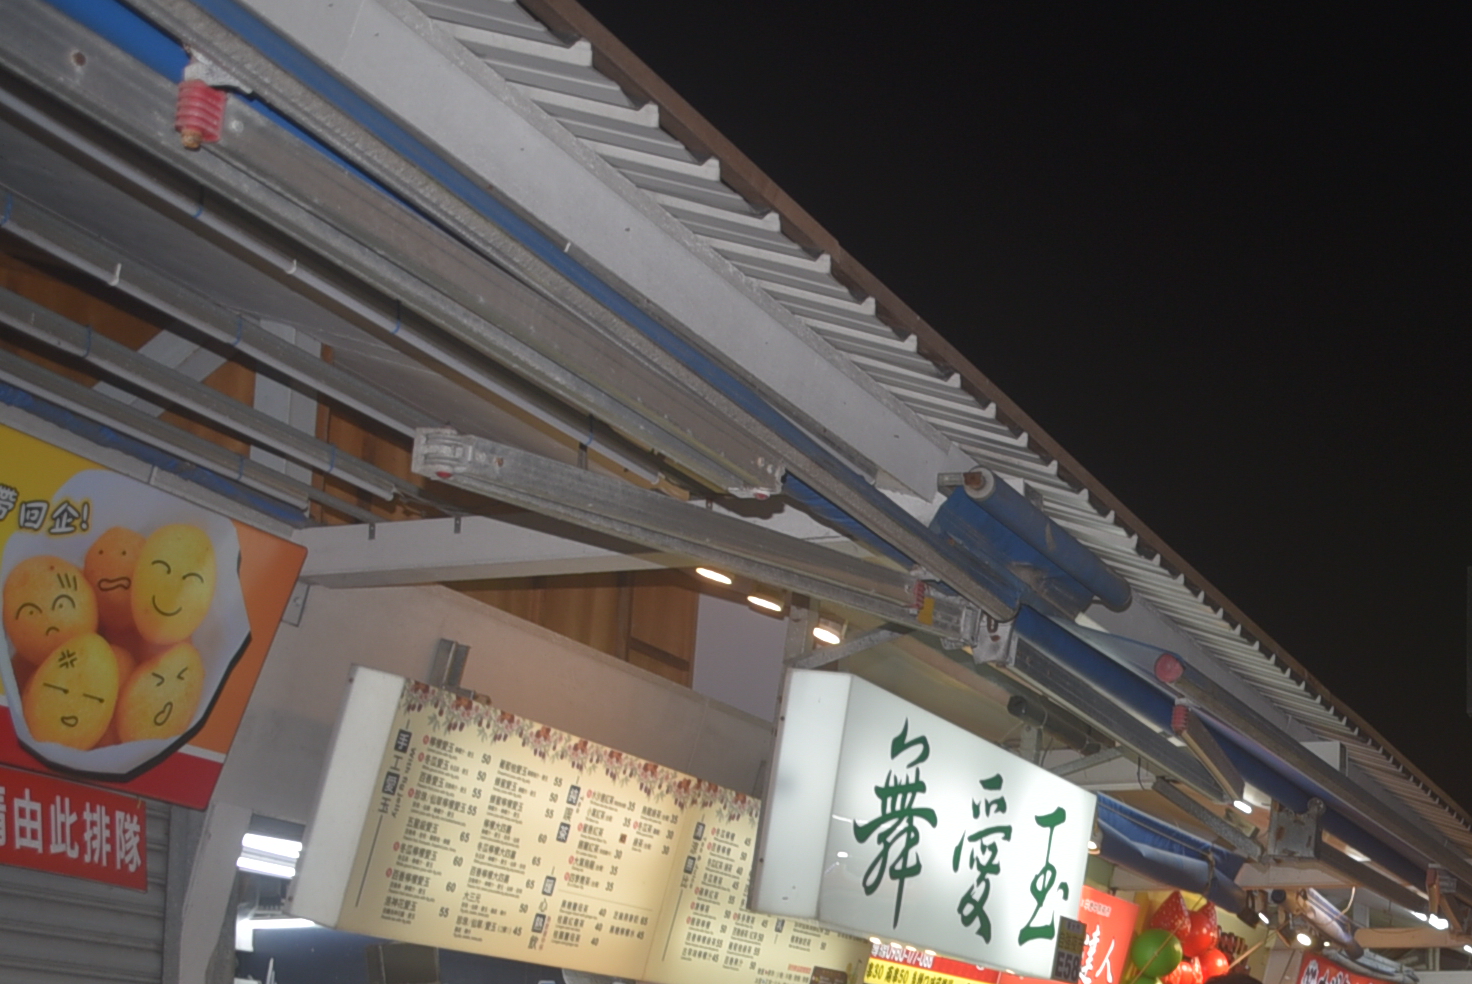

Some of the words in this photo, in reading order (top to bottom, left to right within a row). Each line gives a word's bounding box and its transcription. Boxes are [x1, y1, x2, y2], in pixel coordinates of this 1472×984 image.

[0, 786, 142, 872] 由此排隊
[853, 717, 1069, 945] 舞愛玉
[1055, 952, 1080, 980] E58
